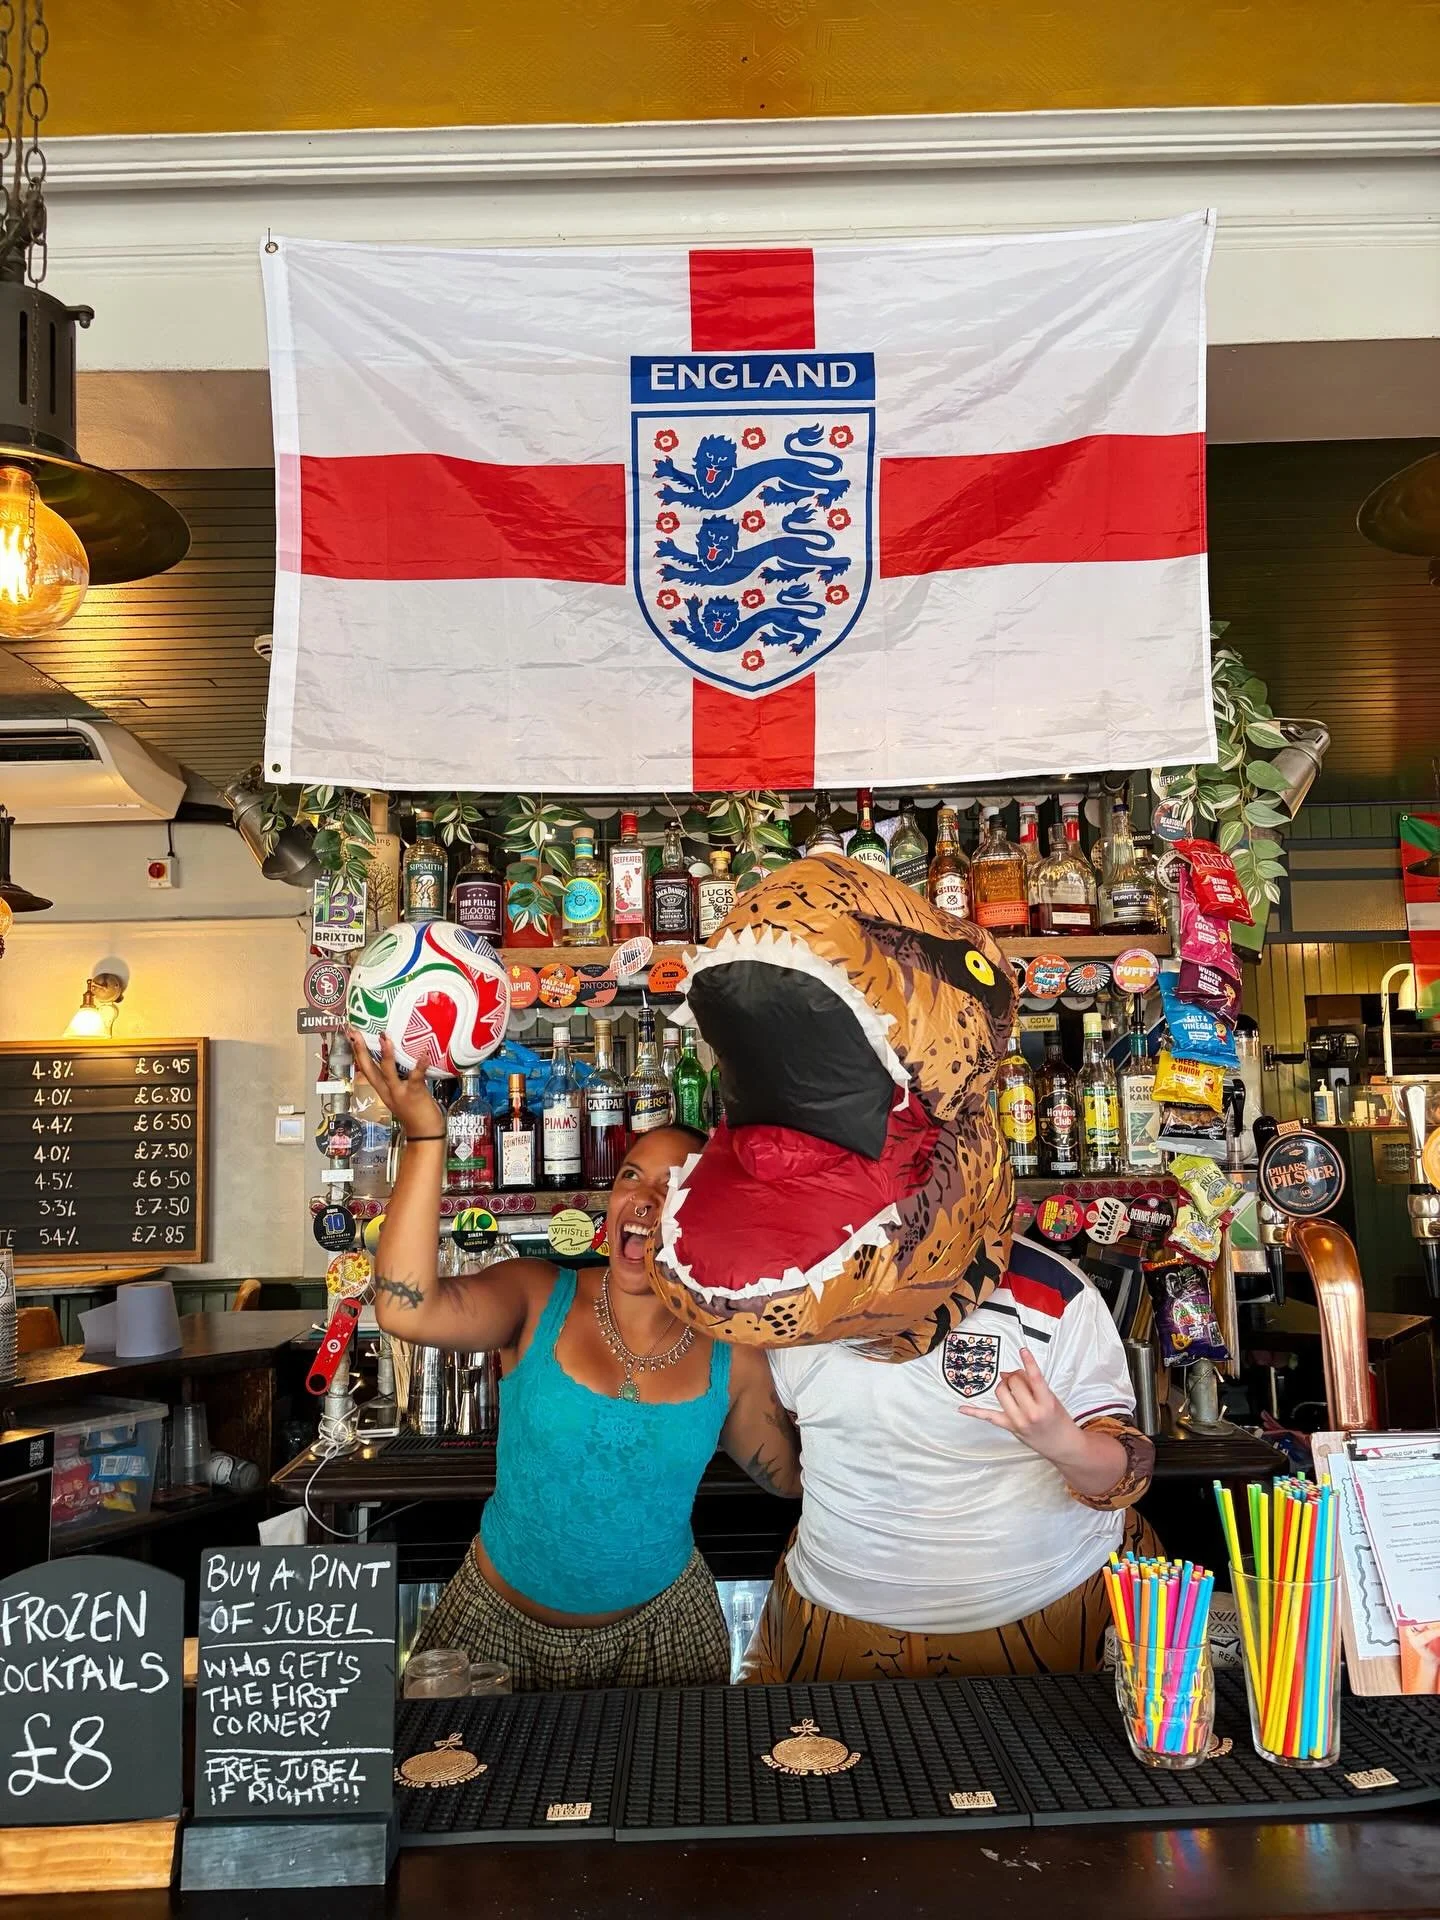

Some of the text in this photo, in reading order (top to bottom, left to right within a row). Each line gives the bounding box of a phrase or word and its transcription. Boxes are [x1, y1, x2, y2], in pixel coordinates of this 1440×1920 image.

[650, 361, 857, 390] ENGLAND
[614, 856, 641, 865] BEEFEATER
[854, 852, 886, 865] AMESON
[409, 863, 443, 872] SIPSMITH
[656, 887, 687, 898] JACK DANIEL'S
[937, 886, 965, 895] CHIVAS
[709, 896, 733, 904] SOD
[460, 907, 496, 916] BLOODY
[315, 932, 364, 943] BRIXTON
[622, 947, 641, 966] JUBEL
[510, 981, 532, 992] AIPUR
[541, 978, 575, 990] HALF-TIME
[580, 982, 616, 990] ONTOON
[1199, 973, 1219, 986] SAUCE
[541, 984, 573, 995] ORANGES
[314, 993, 341, 1004] BREWERY
[1183, 1022, 1213, 1030] VINEGAR
[1171, 1063, 1201, 1077] & ONION
[1175, 1058, 1199, 1068] CHEESE
[134, 1087, 191, 1105] £6.80
[1008, 1103, 1033, 1112] Havana
[1047, 1108, 1076, 1118] Havana
[133, 1114, 192, 1133] £6.50
[544, 1114, 577, 1130] PIMM'S
[1015, 1111, 1032, 1121] Club
[1054, 1117, 1072, 1126] Club
[1060, 1134, 1067, 1144] 7
[134, 1141, 191, 1161] £7.50
[1269, 1161, 1308, 1177] PILLARS
[132, 1170, 191, 1189] £6.50
[1200, 1170, 1221, 1191] FRIES
[1271, 1165, 1335, 1191] PILSNER
[134, 1197, 190, 1217] £7.50
[323, 1213, 345, 1235] 10
[132, 1225, 186, 1244] £7.85
[551, 1227, 591, 1238] WHISTLE
[526, 1247, 548, 1256] Push
[207, 1554, 391, 1593] BUY A PINT
[0, 1591, 147, 1647] FROZEN
[208, 1600, 374, 1638] OF JUBEL
[203, 1651, 361, 1684] WHO GET'S
[202, 1684, 349, 1712] THE FIRST
[213, 1711, 331, 1745] CORNER?
[8, 1713, 112, 1796] £8
[204, 1758, 272, 1783] FREE
[279, 1758, 367, 1783] JUBEL
[761, 1751, 862, 1776] LOST AND GROUNDED
[401, 1763, 488, 1790] AND GROUNDED
[210, 1781, 361, 1806] IF RIGHT!!!
